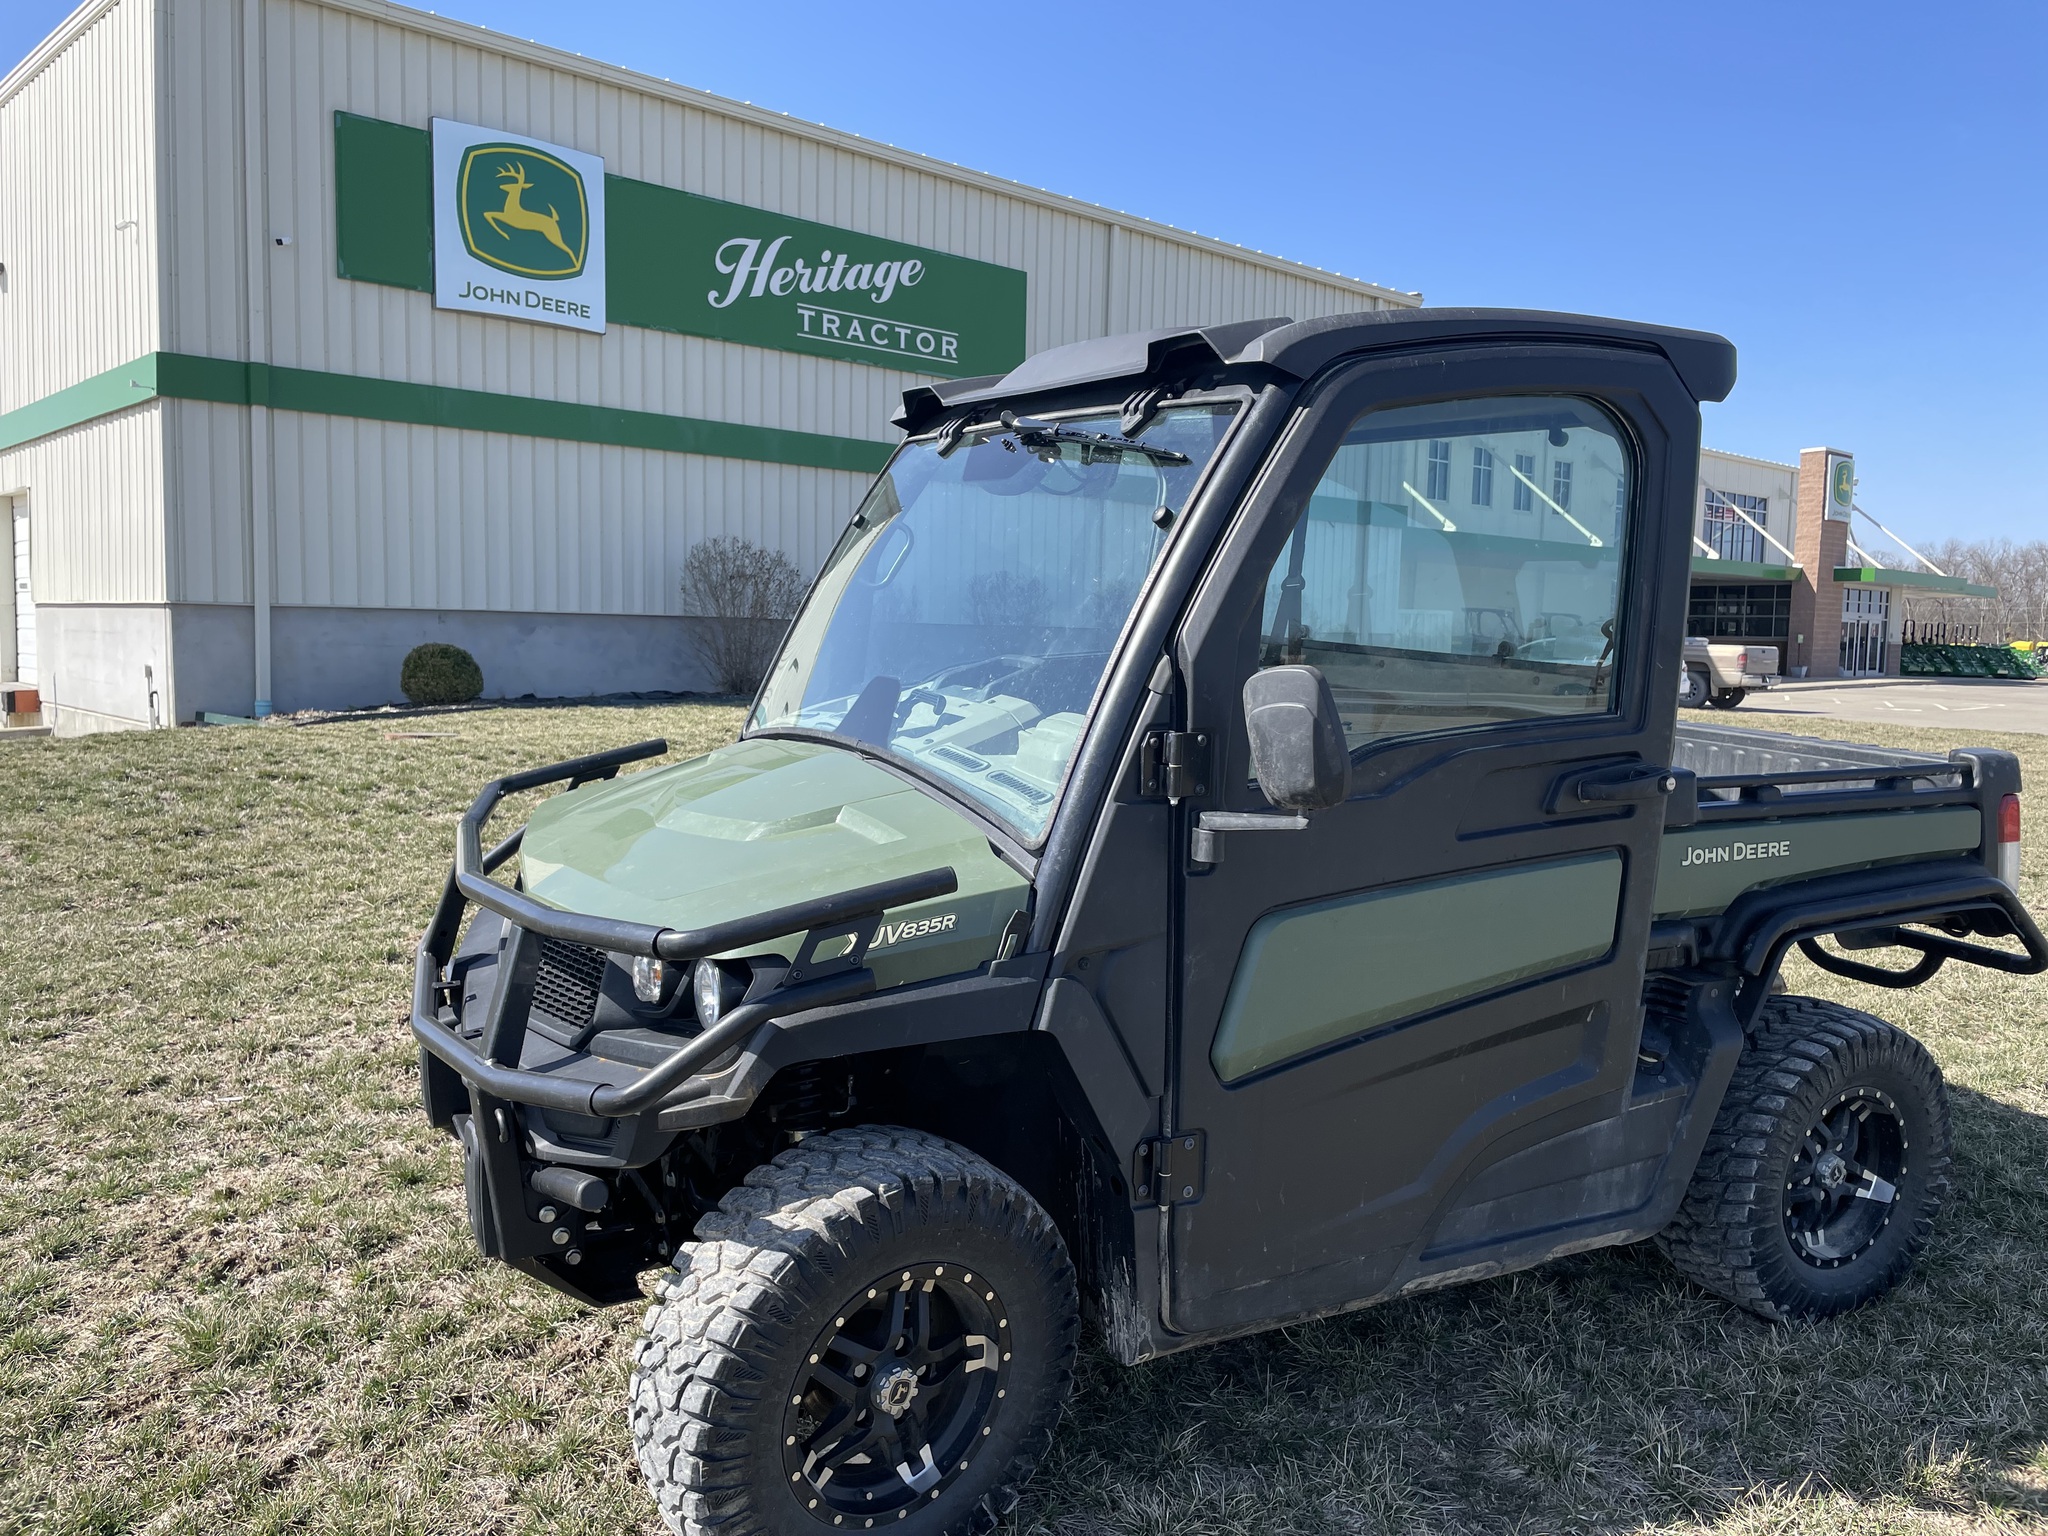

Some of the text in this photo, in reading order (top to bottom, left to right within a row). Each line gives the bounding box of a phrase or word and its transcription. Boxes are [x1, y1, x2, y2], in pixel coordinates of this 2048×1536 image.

[707, 236, 926, 308] Heritage
[458, 281, 591, 319] JOHN DEERE
[797, 308, 958, 358] TRACTOR
[1681, 840, 1790, 867] JOHN DEERE
